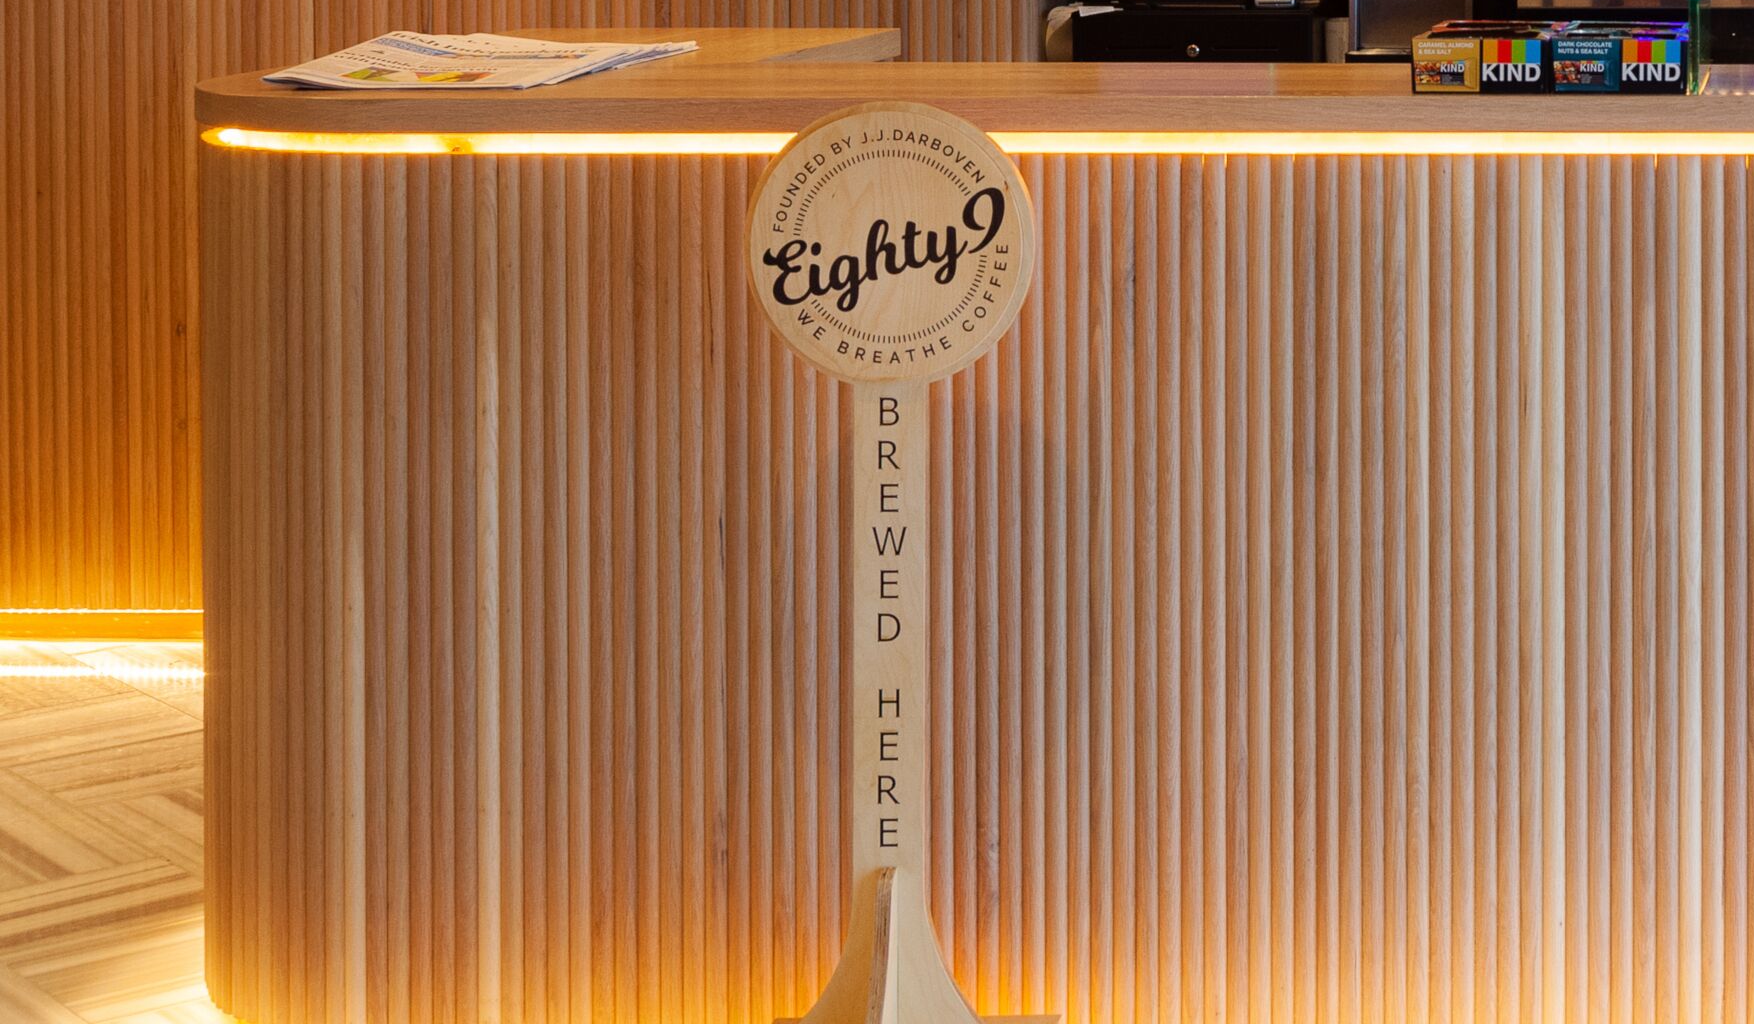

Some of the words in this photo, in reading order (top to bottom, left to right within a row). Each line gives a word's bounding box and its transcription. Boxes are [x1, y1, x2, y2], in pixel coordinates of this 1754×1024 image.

[1440, 64, 1465, 73] KIND
[1482, 63, 1541, 82] KIND
[1580, 63, 1605, 72] KIND
[1622, 63, 1681, 82] KIND
[773, 153, 826, 233] FOUNDED
[830, 136, 852, 155] BY
[861, 129, 986, 184] J.J.DARBOVEN
[763, 187, 1005, 312] Eighty9
[797, 309, 826, 341] WE
[837, 335, 952, 364] BREATHE
[962, 244, 1009, 333] COFFEE
[872, 397, 907, 643] BREWED
[877, 688, 901, 848] HERE
